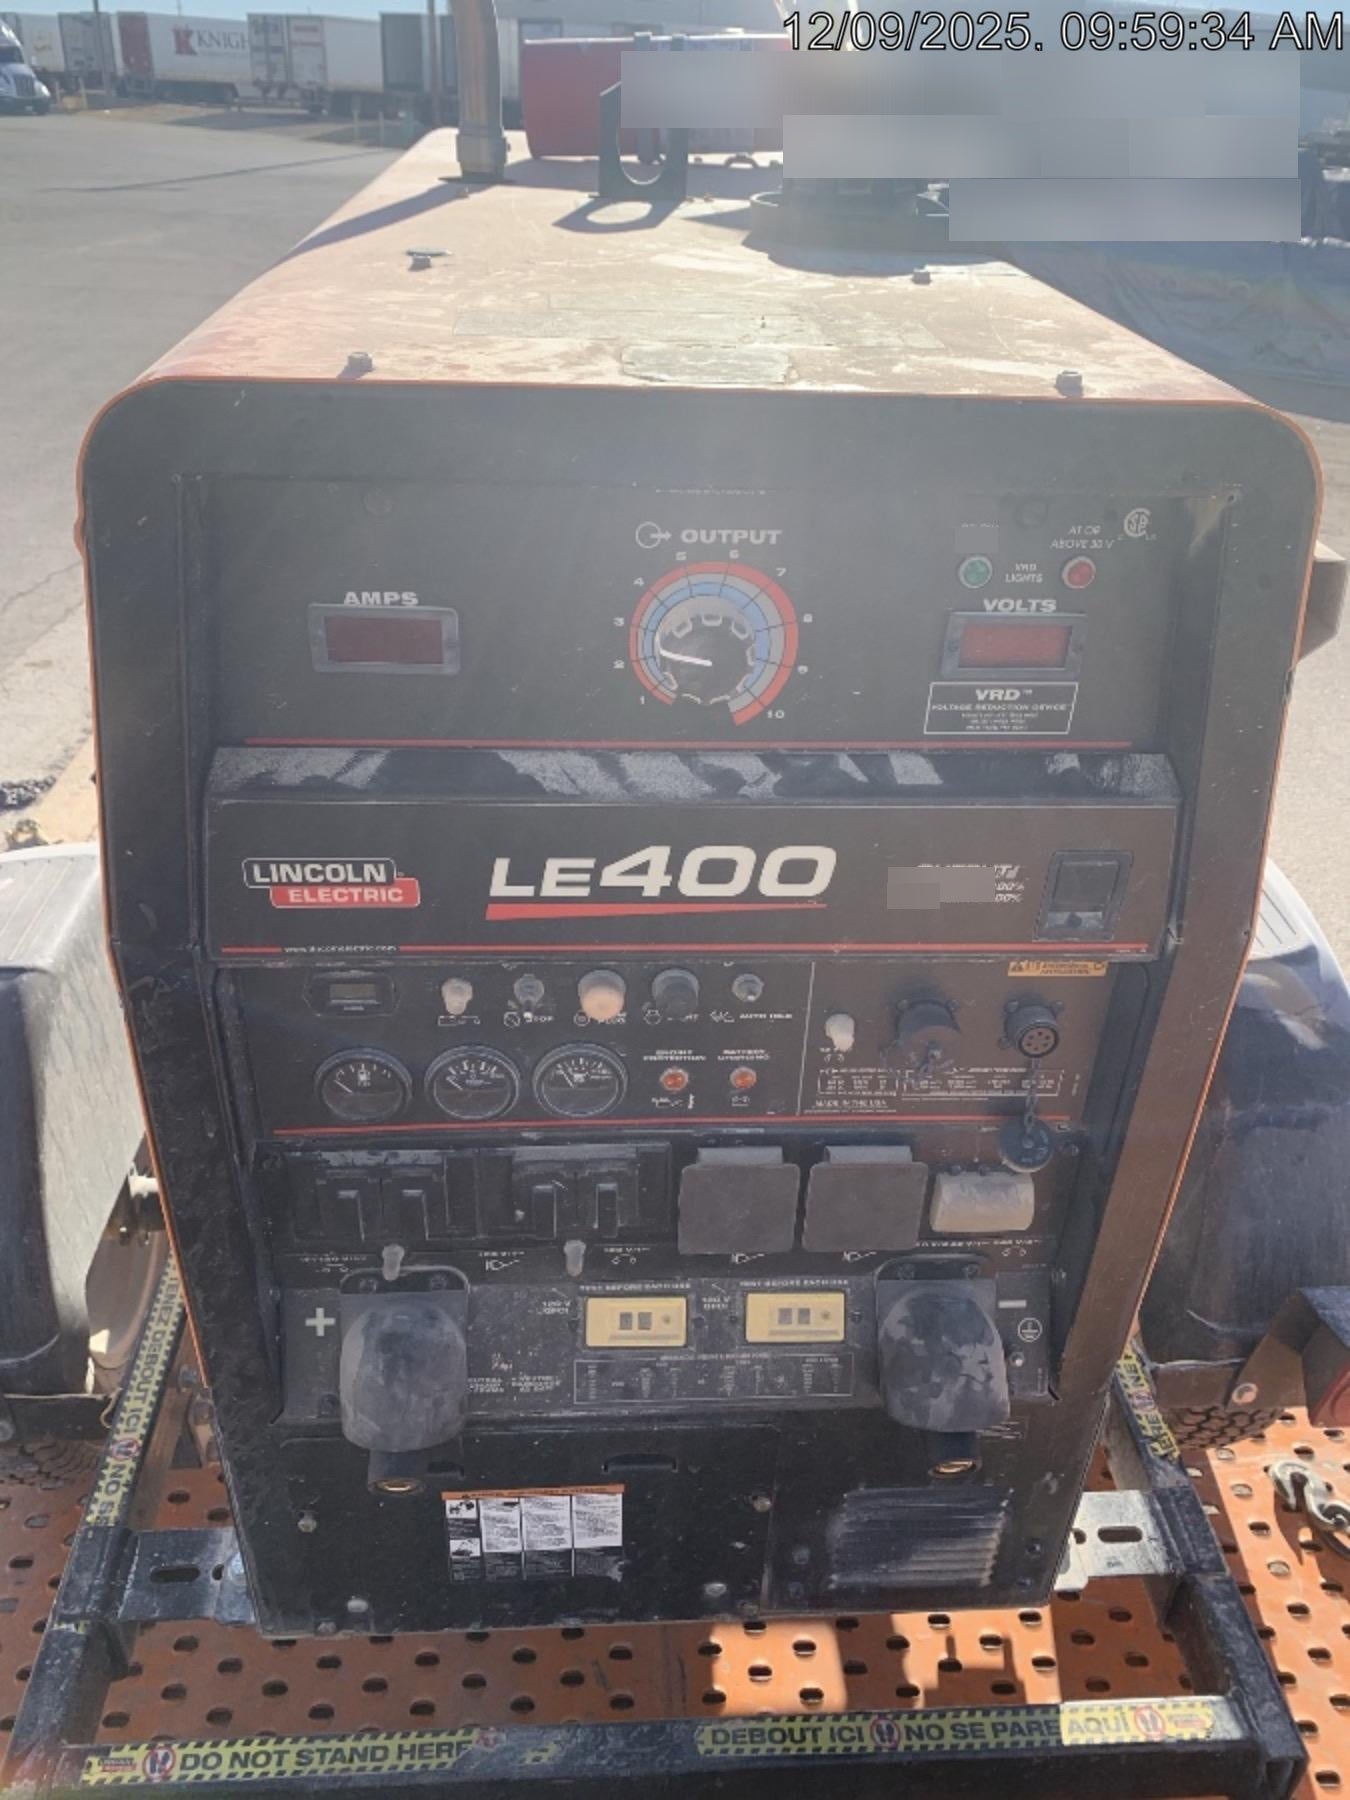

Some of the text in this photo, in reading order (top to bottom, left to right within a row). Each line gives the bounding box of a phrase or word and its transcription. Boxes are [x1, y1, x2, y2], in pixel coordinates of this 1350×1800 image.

[680, 529, 782, 544] OUTPUT
[633, 577, 645, 586] 4
[776, 568, 786, 577] 7
[344, 591, 419, 607] AMPS
[983, 599, 1057, 613] VOLTS
[767, 710, 785, 719] 10
[252, 863, 387, 883] LINCOLN
[489, 845, 837, 897] LE400
[287, 887, 405, 903] ELECTRIC
[134, 1330, 169, 1401] DEBOUT
[123, 1406, 141, 1434] ICI
[105, 1463, 126, 1496] NO
[710, 1724, 865, 1747] DEBOUT ICI
[905, 1722, 945, 1742] NO
[951, 1721, 988, 1741] SE
[993, 1718, 1060, 1740] PARE
[179, 1752, 222, 1772] DO
[228, 1748, 290, 1769] NOT
[295, 1744, 389, 1767] STAND
